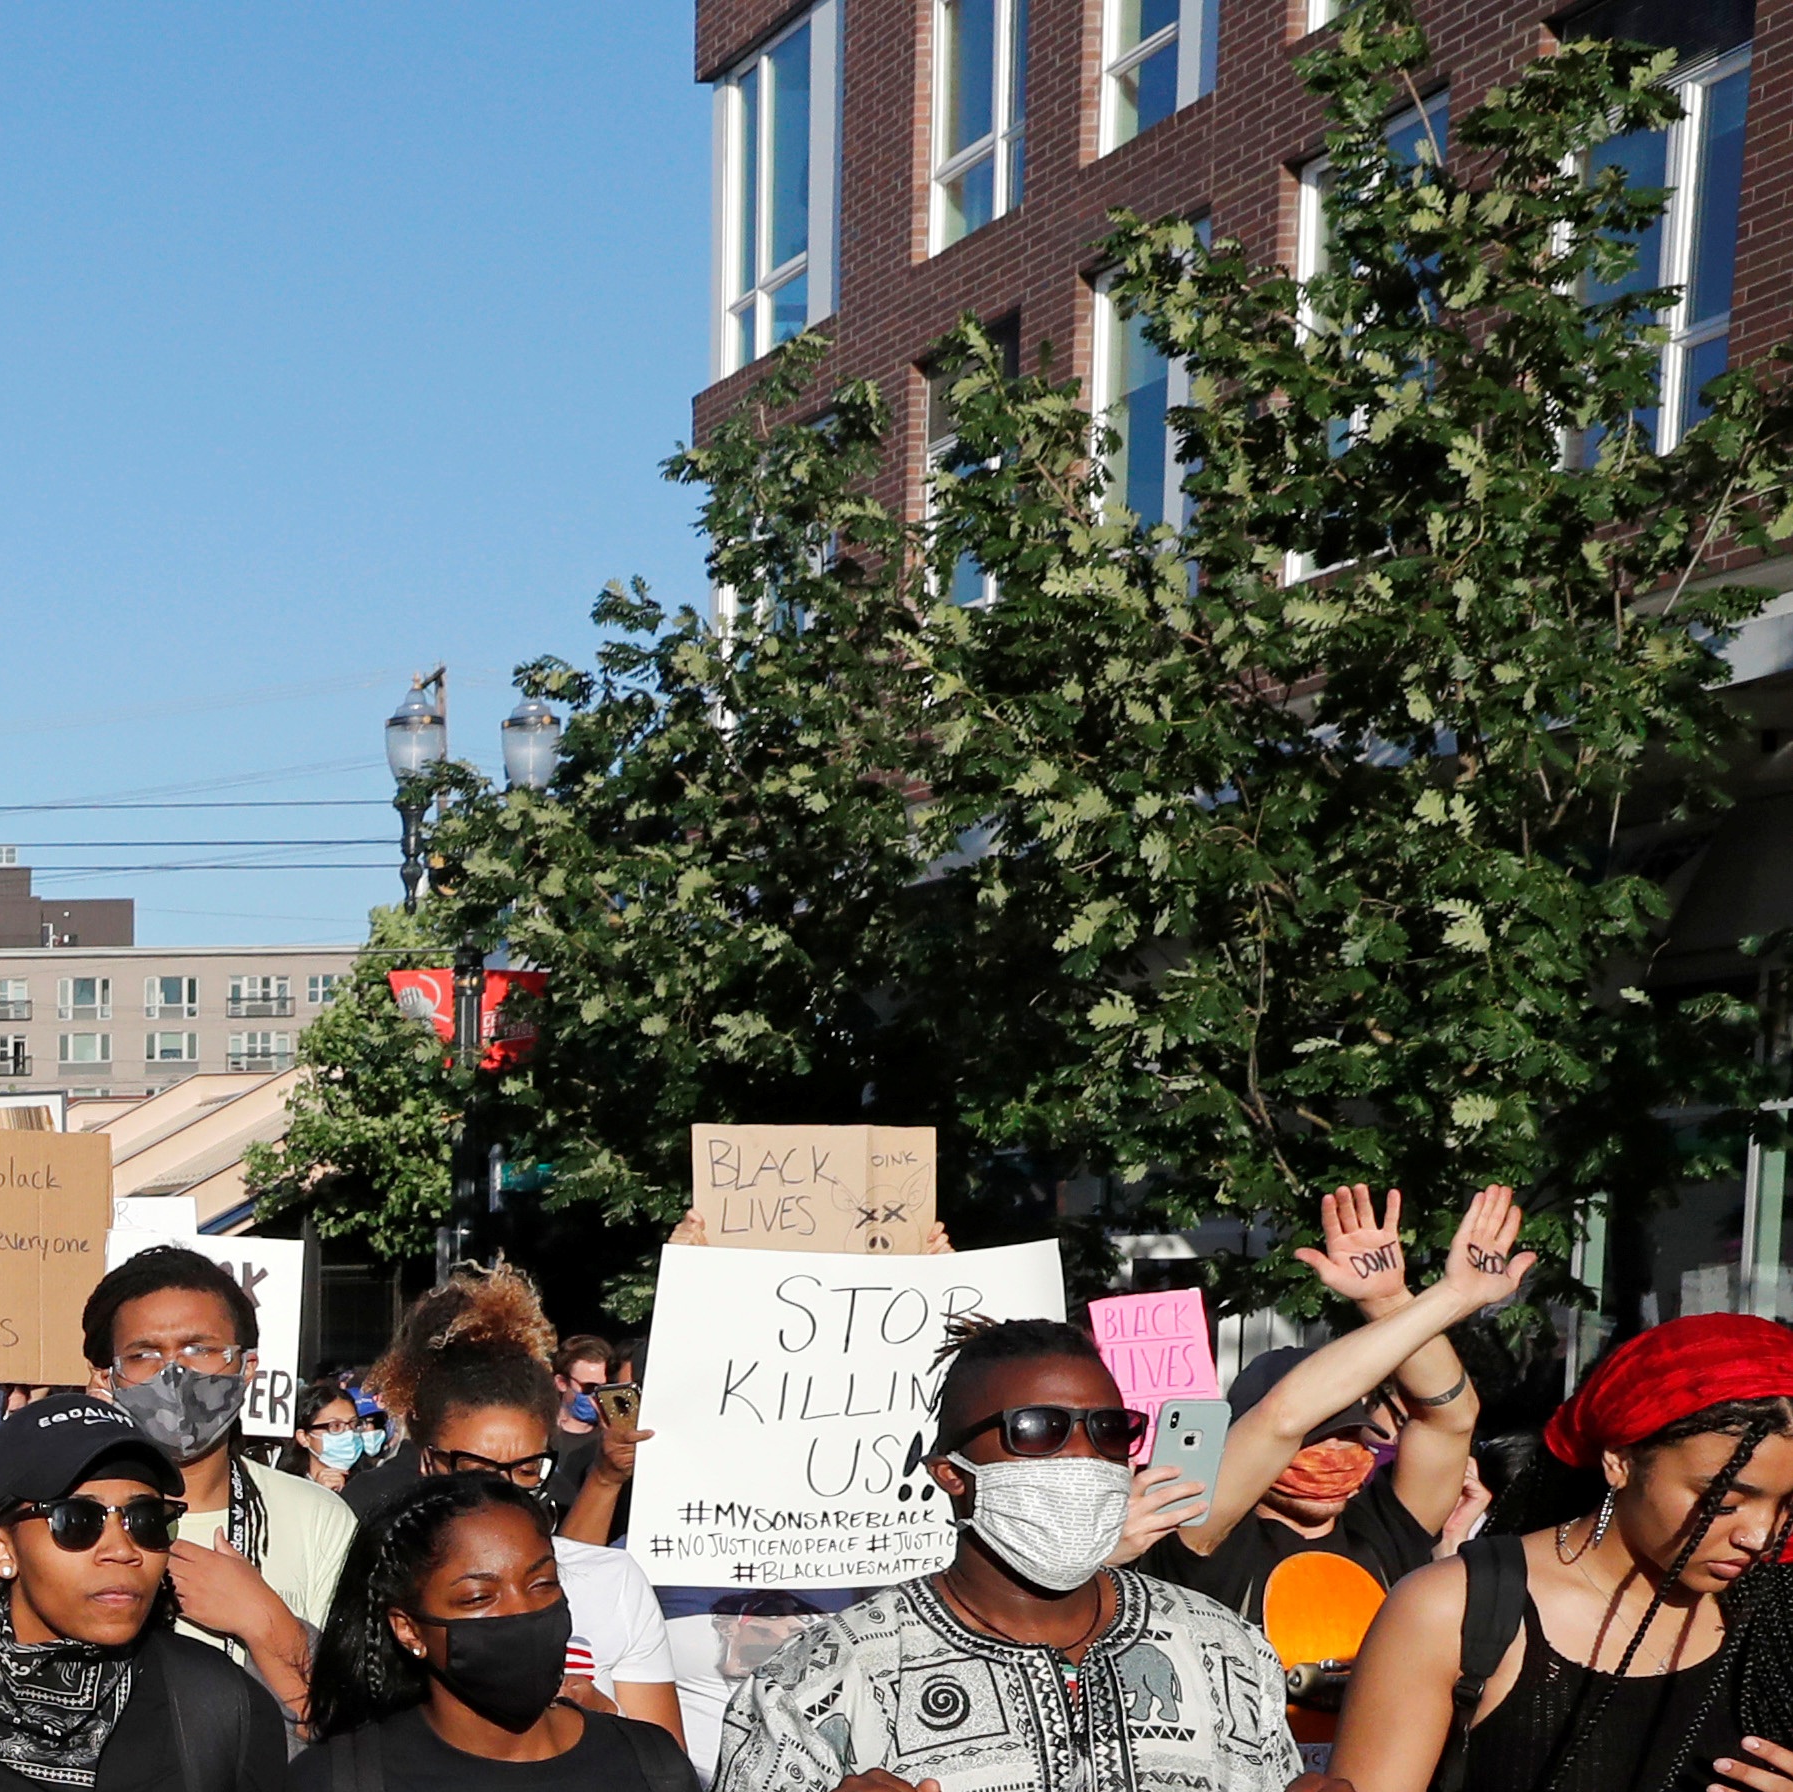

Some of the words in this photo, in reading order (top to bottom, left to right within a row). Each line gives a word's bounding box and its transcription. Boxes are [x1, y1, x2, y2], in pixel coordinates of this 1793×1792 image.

[708, 1139, 839, 1191] BLACK
[870, 1150, 918, 1168] OINK
[721, 1195, 816, 1236] LIVES
[1349, 1240, 1397, 1279] DONT
[776, 1274, 985, 1354] STOP
[1103, 1303, 1190, 1340] BLACK
[1110, 1343, 1196, 1393] LIVES
[721, 1360, 945, 1426] KILLIN
[38, 1407, 135, 1428] EQUALITY
[677, 1499, 936, 1532] #MYSONSAREBLACK
[865, 1529, 958, 1554] #JUSTIC
[730, 1556, 946, 1584] #BLACKLIVESMATTER
